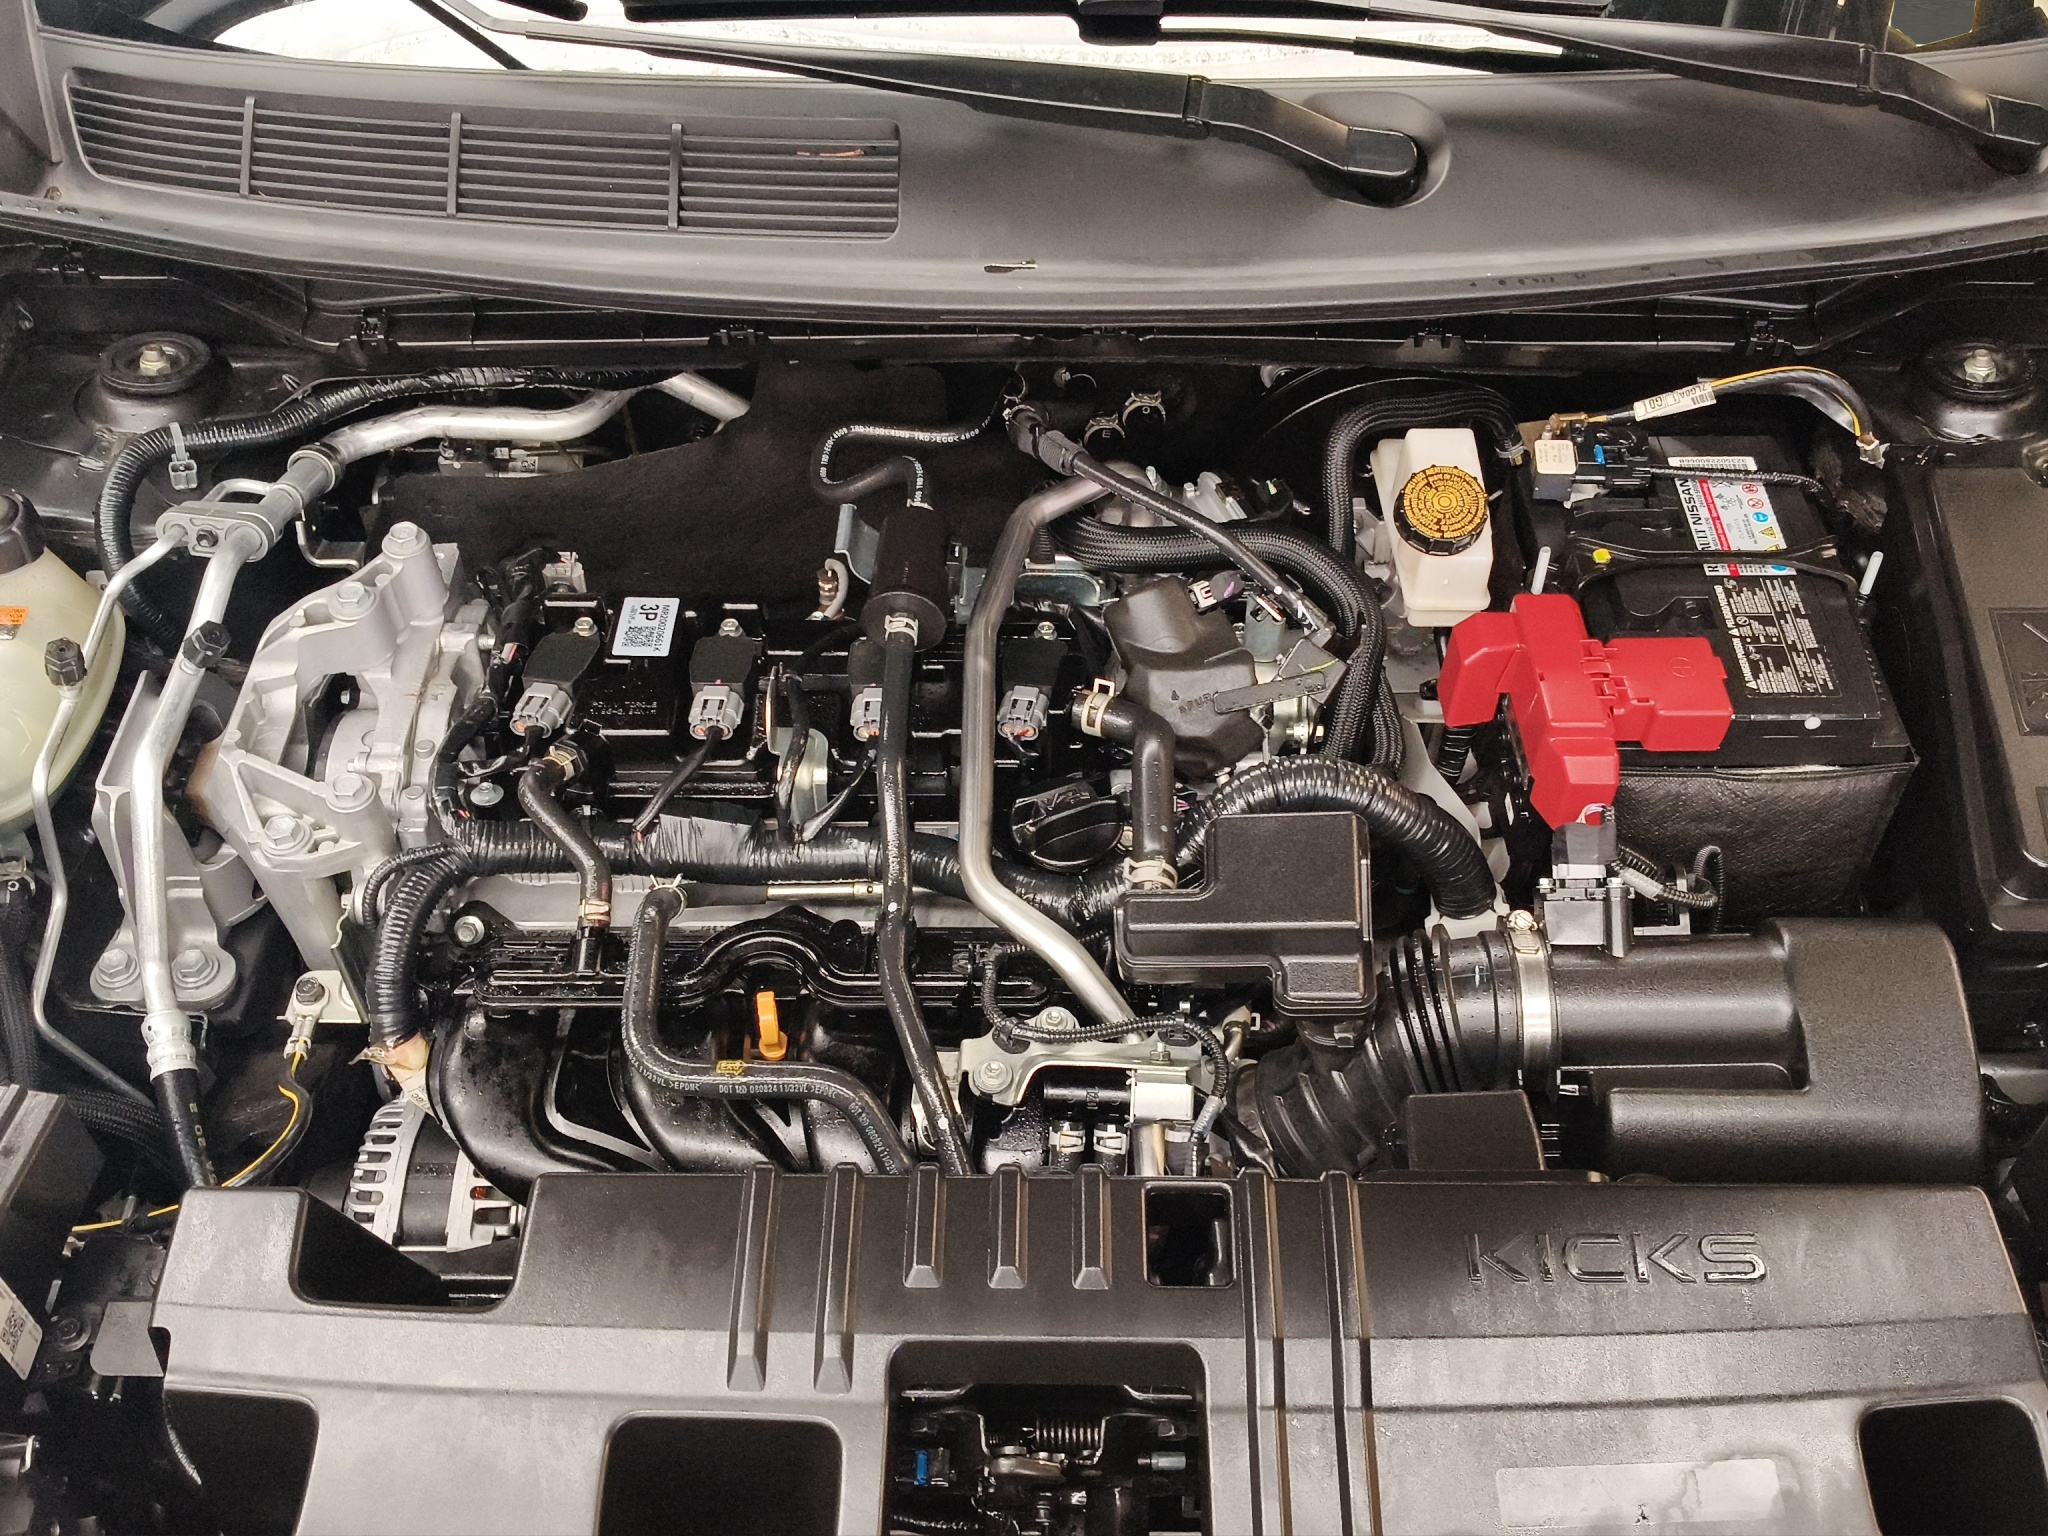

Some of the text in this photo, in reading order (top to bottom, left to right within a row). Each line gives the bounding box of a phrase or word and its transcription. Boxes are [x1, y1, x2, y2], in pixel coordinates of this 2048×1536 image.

[1677, 478, 1702, 524] NISSAN
[638, 604, 659, 620] 3P
[1465, 1230, 1768, 1284] KICKS
